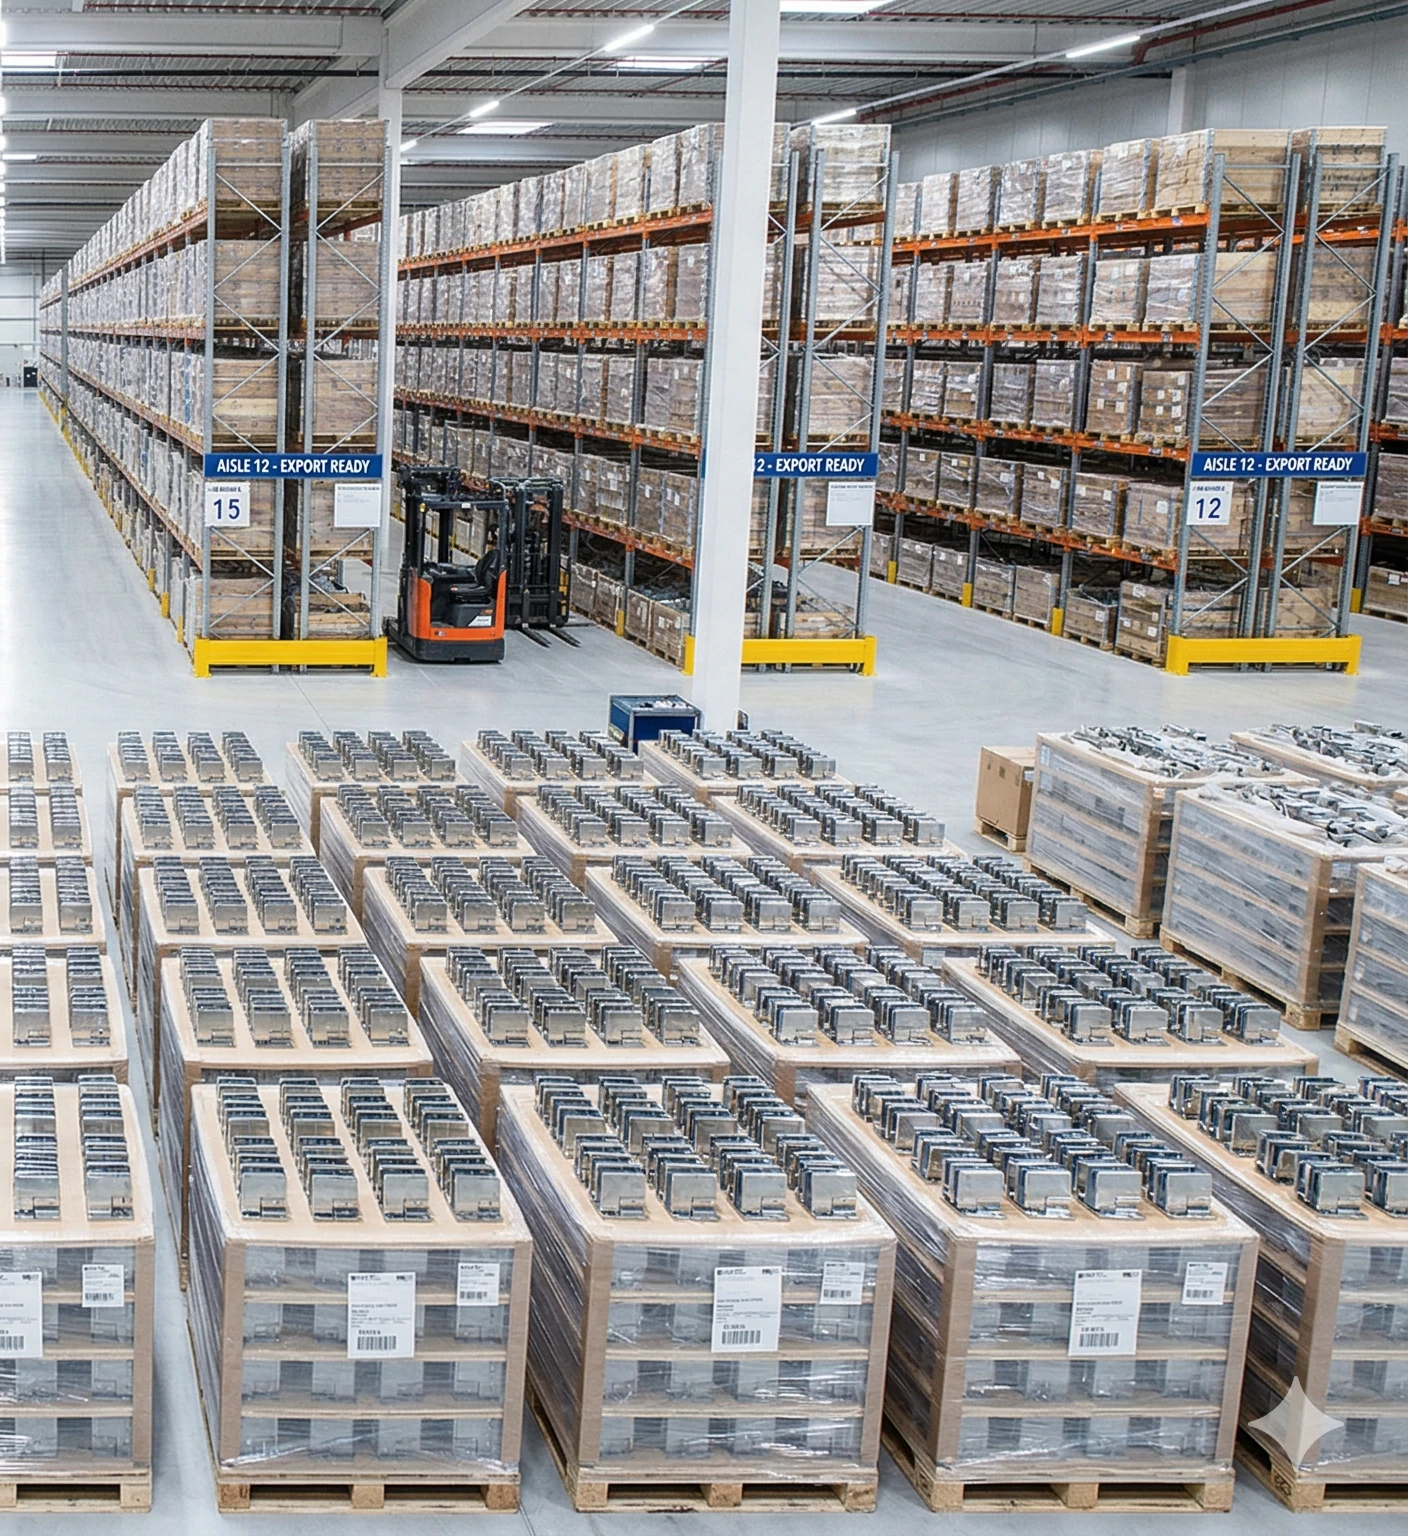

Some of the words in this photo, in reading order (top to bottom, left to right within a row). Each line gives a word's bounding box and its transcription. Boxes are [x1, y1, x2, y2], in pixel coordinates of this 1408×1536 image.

[216, 458, 251, 473] AISLE
[253, 458, 270, 473] 12
[280, 458, 328, 473] EXPORT
[330, 458, 371, 473] READY
[775, 458, 824, 472] EXPORT
[825, 458, 865, 472] READY
[1203, 457, 1237, 471] AISLE
[1240, 457, 1255, 471] 12
[1265, 457, 1312, 471] EXPORT
[1313, 457, 1353, 471] READY
[213, 499, 240, 520] 15
[1196, 497, 1222, 519] 12
